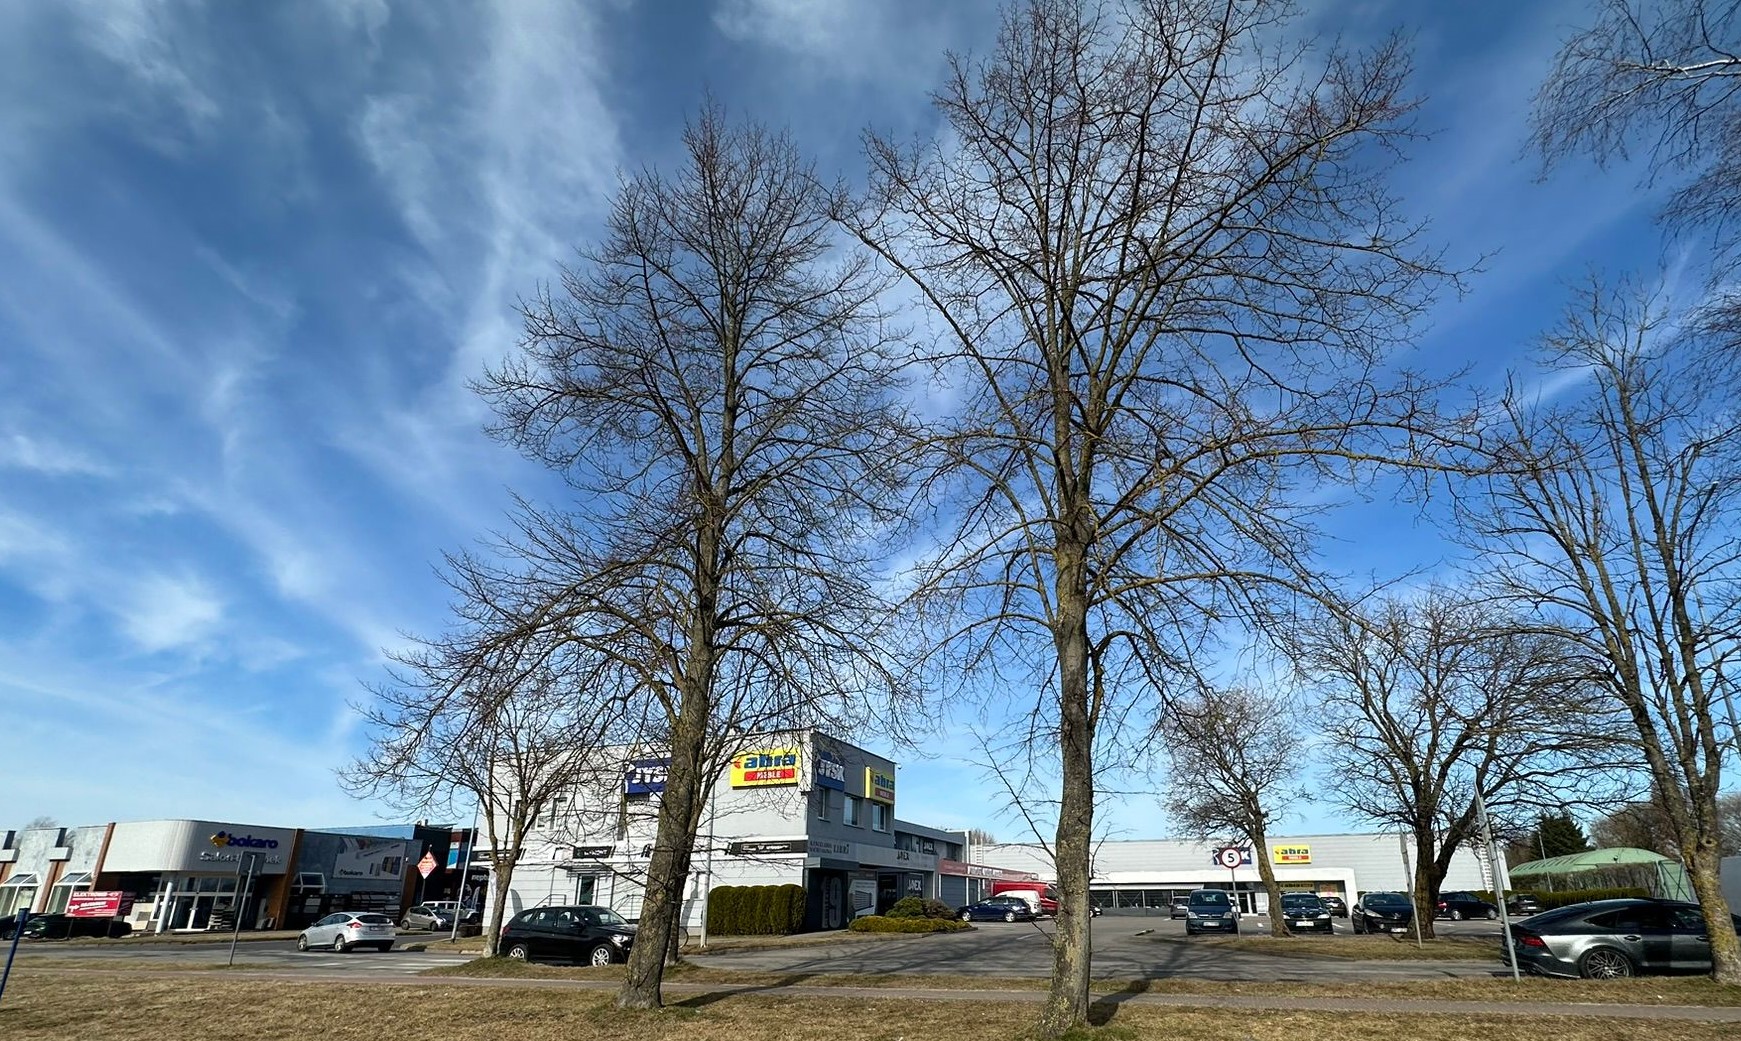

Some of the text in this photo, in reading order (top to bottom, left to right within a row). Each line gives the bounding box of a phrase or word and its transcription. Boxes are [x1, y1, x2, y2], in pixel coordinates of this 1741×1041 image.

[744, 753, 796, 769] abra
[227, 833, 279, 849] bokaro
[1227, 852, 1235, 863] 5
